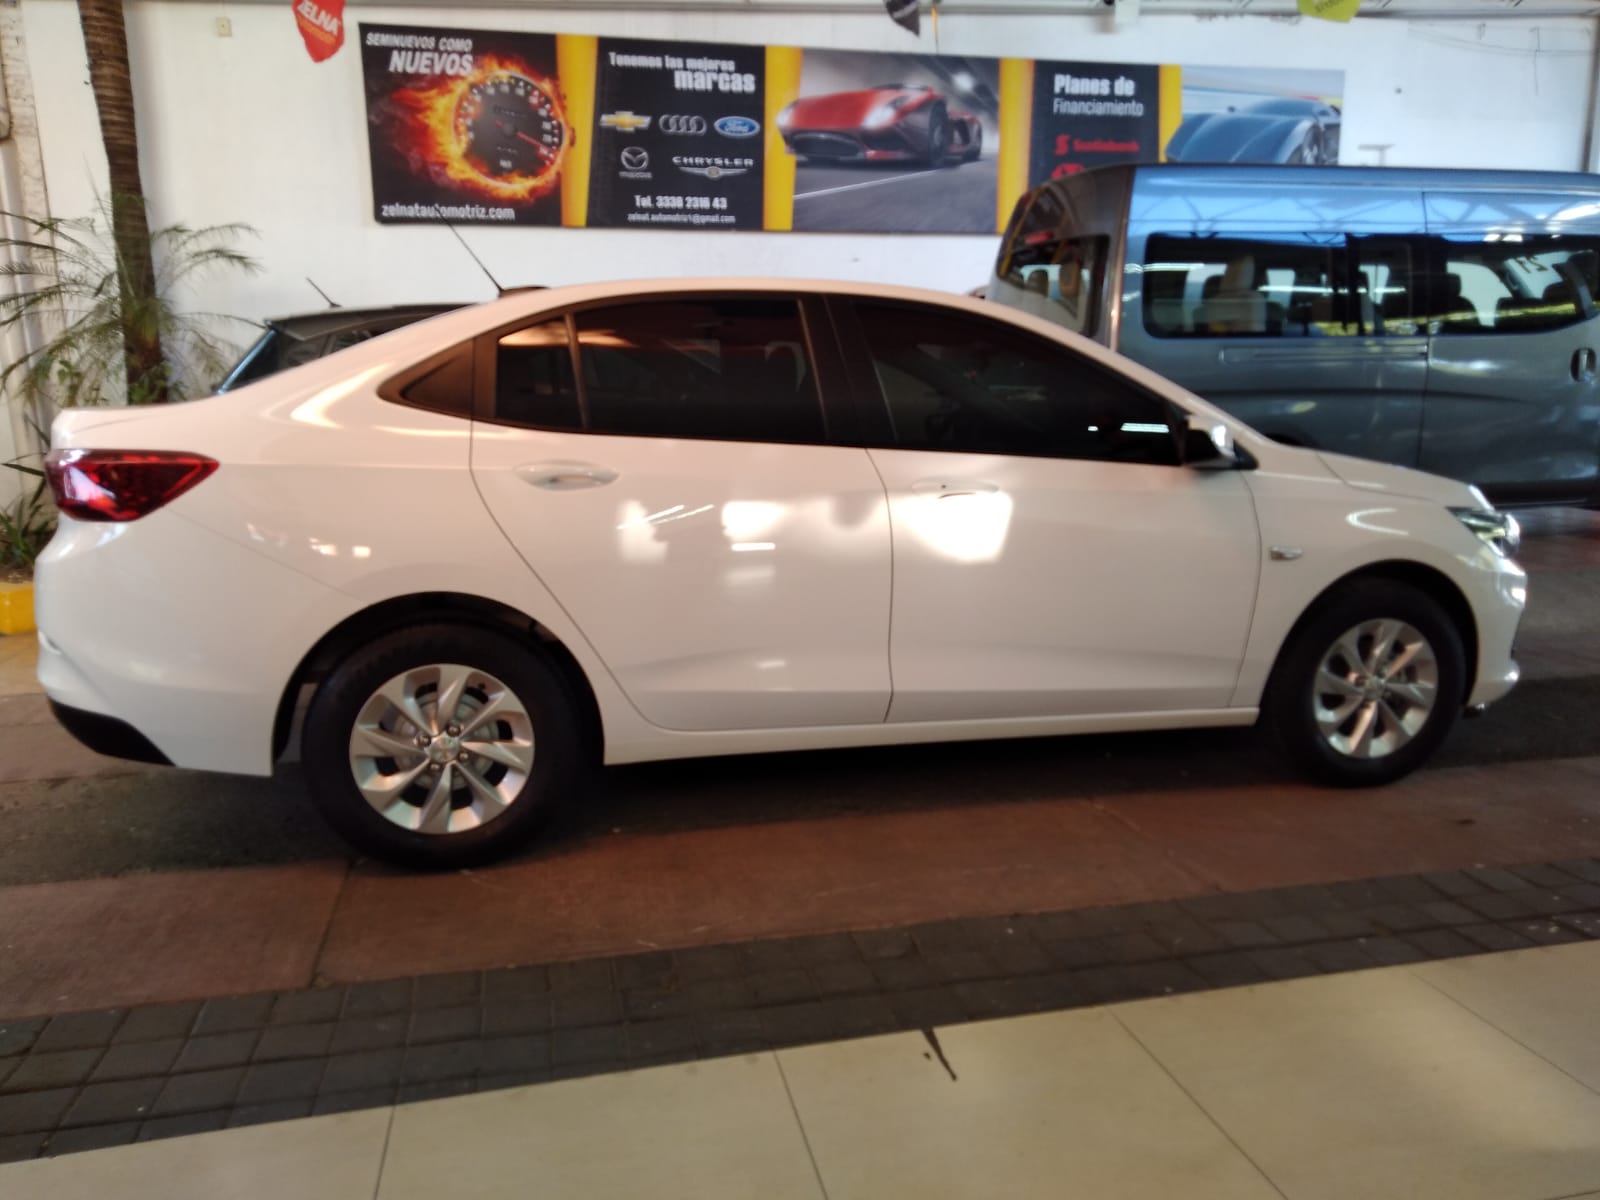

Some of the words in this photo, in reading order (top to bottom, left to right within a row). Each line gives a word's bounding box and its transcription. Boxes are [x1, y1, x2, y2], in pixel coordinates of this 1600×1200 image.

[366, 32, 435, 49] SEMINUEVOS
[439, 37, 473, 52] COMO
[388, 50, 474, 75] NUEVOS
[609, 52, 662, 68] Tenemos
[665, 55, 684, 69] las
[686, 58, 735, 72] mejores
[674, 70, 755, 92] marcas
[1054, 74, 1110, 96] Planes
[1114, 76, 1135, 96] de
[1053, 98, 1144, 117] Financiamiento
[672, 156, 754, 166] CHRYSLER
[634, 195, 654, 209] Tel.
